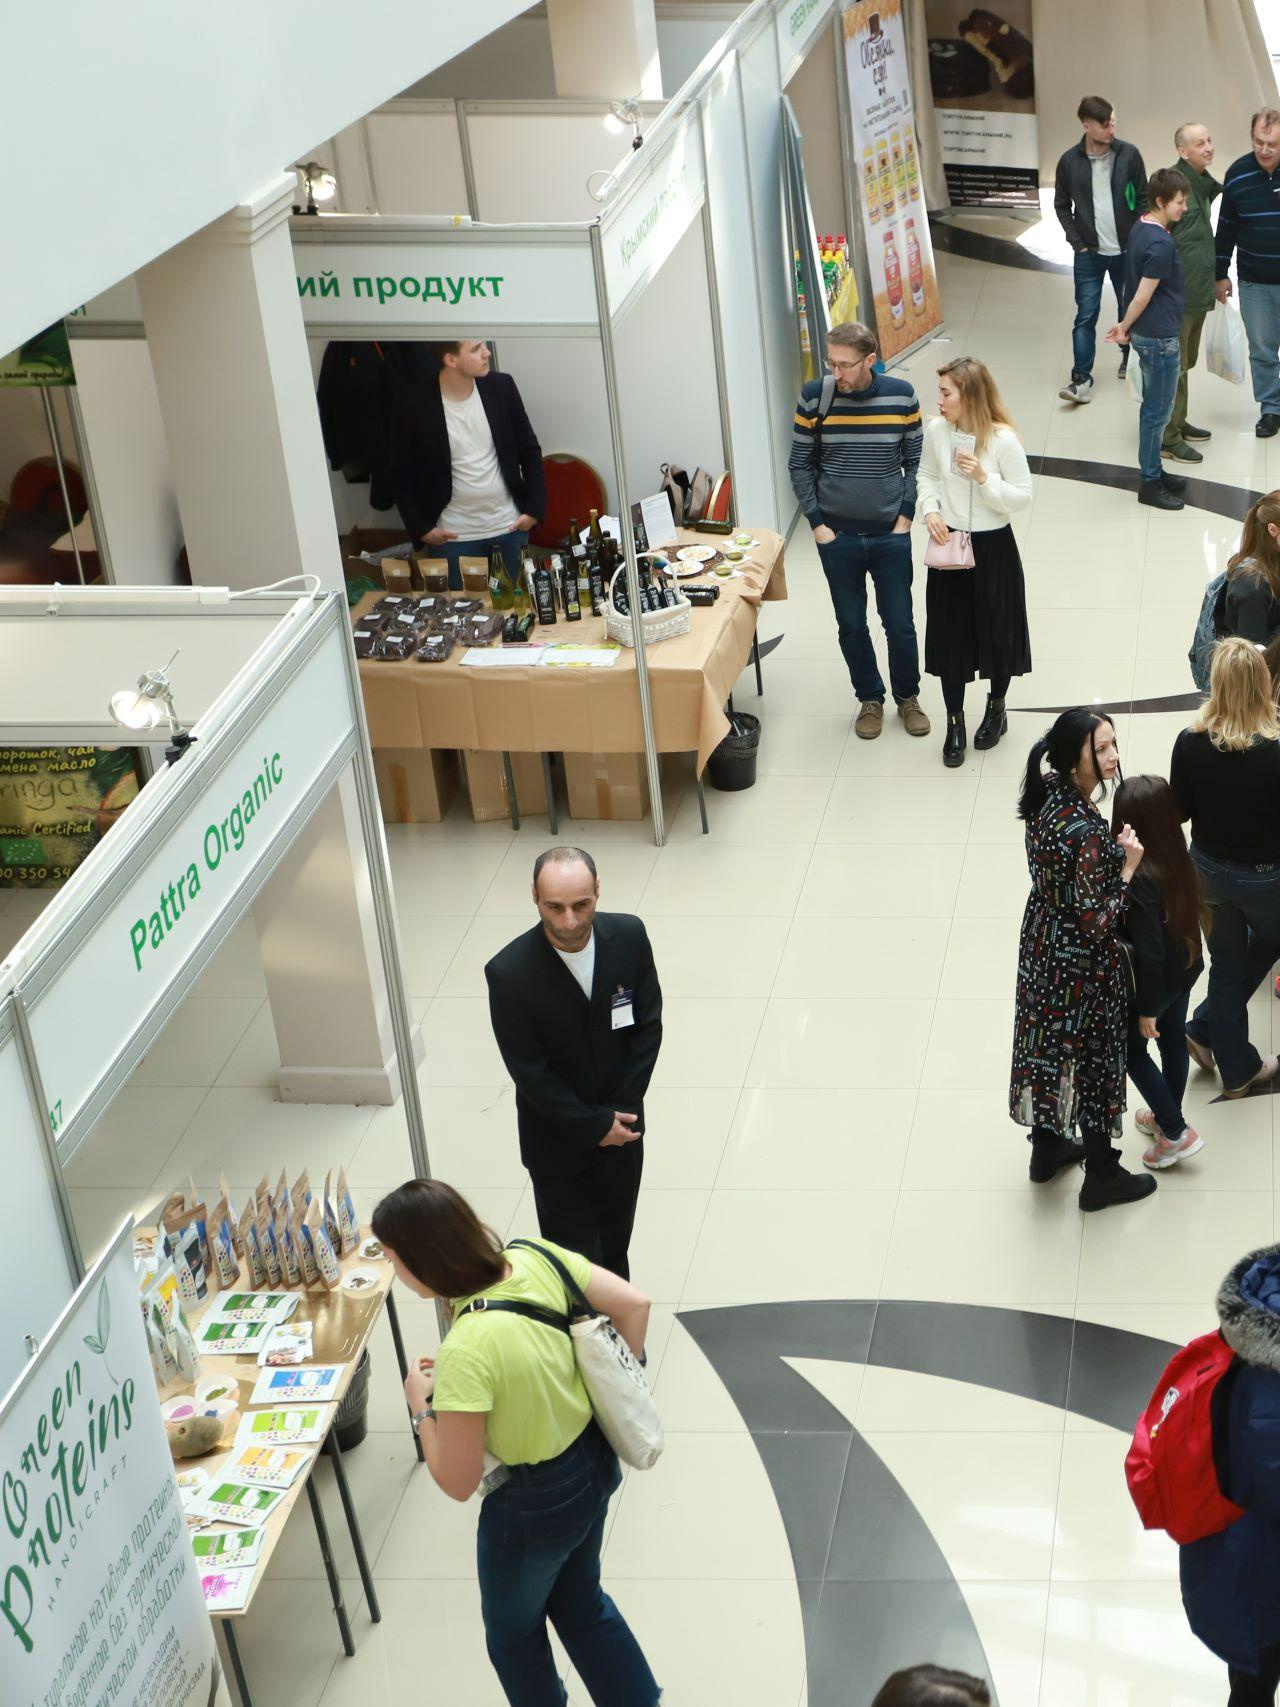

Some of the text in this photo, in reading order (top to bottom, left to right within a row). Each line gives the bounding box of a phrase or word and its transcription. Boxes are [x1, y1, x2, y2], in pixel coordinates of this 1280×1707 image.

[296, 269, 504, 304] ий продукт
[48, 758, 97, 772] масло
[33, 820, 92, 835] Certified
[20, 867, 47, 879] 350
[129, 752, 284, 972] Pattra Organic
[48, 1455, 127, 1612] HANDICRAFT
